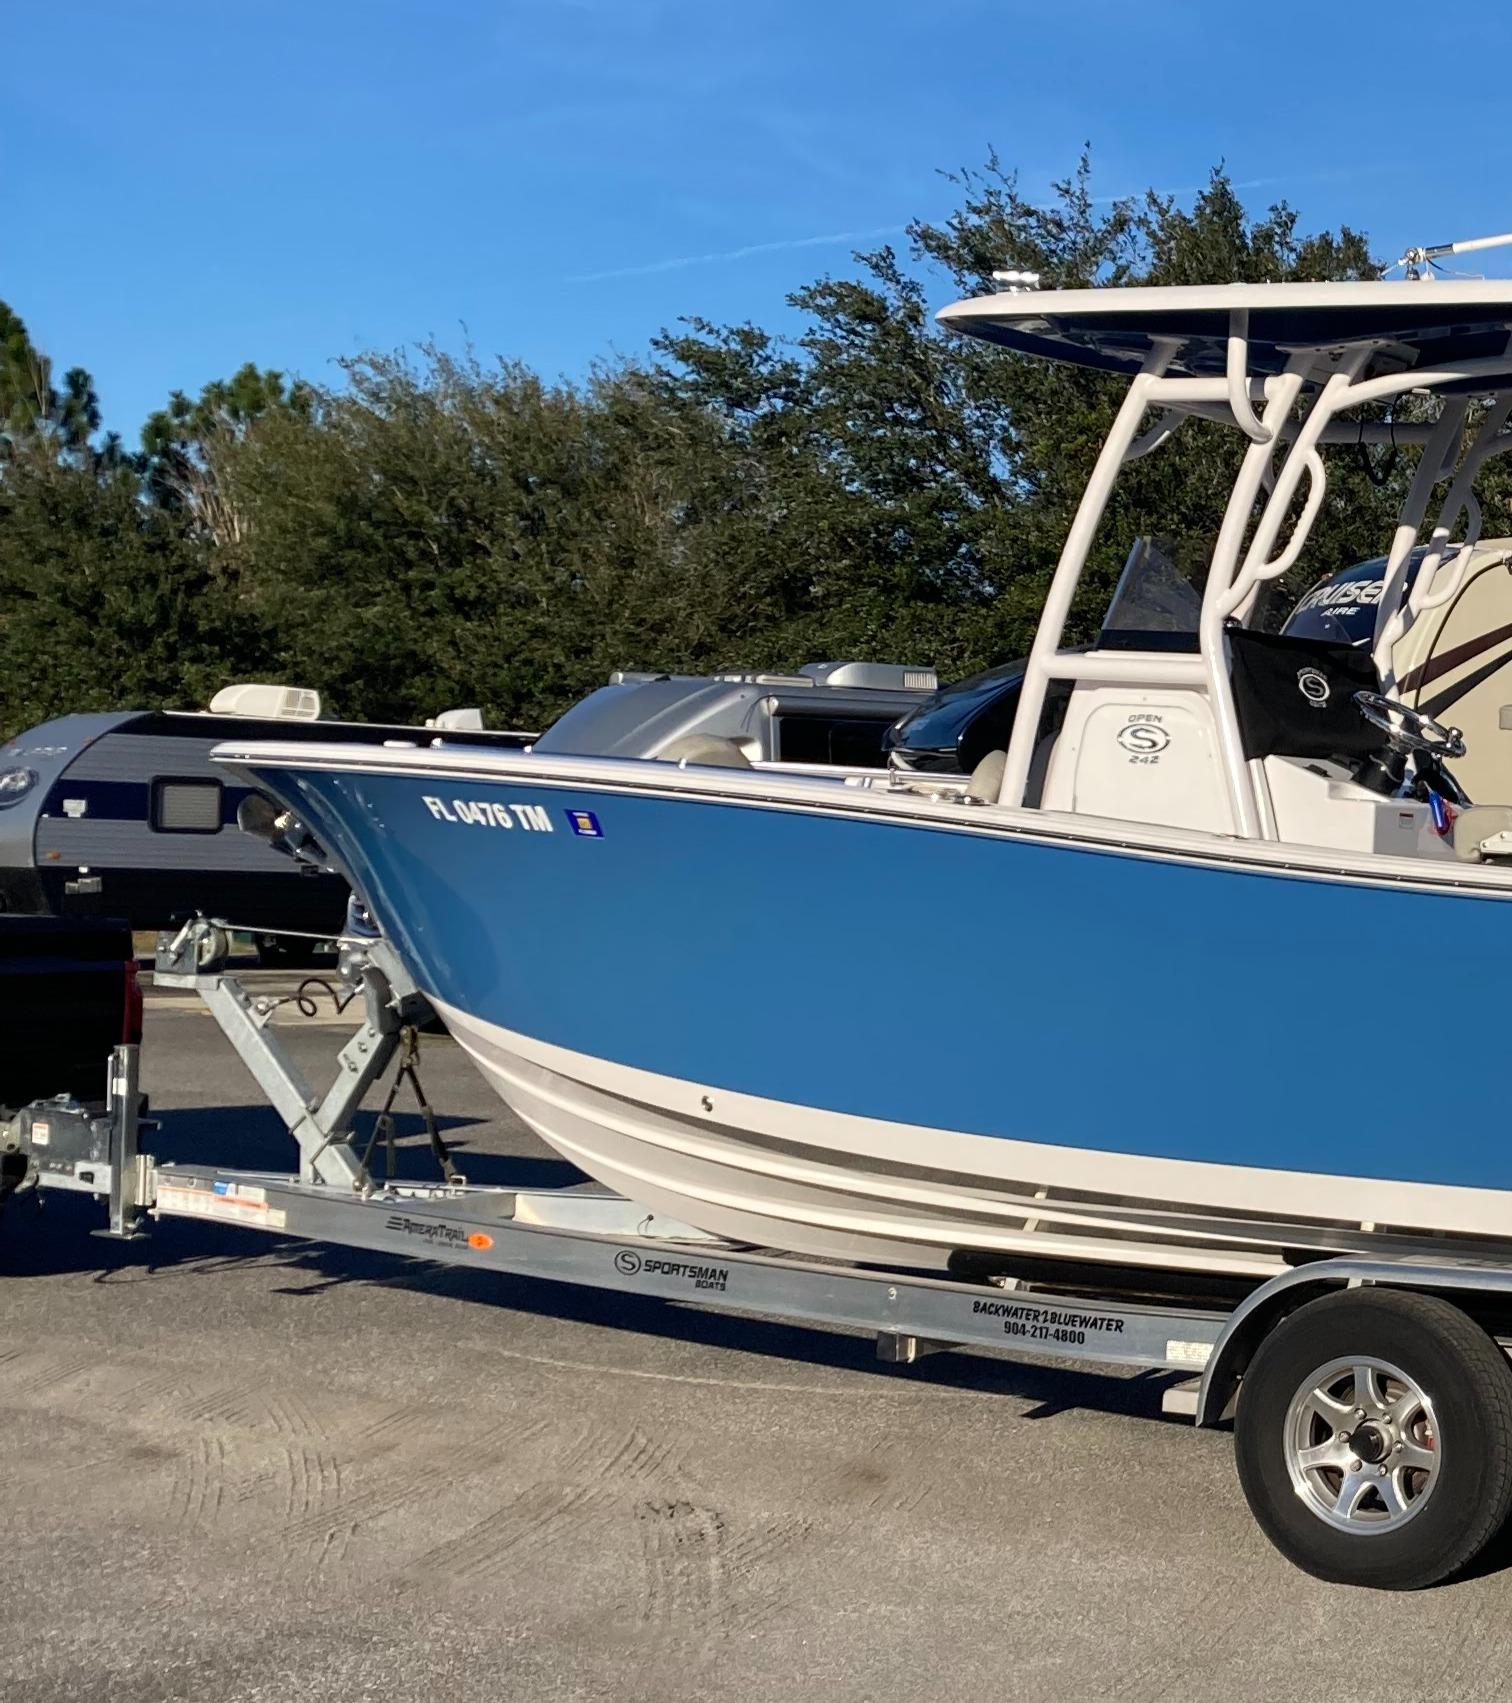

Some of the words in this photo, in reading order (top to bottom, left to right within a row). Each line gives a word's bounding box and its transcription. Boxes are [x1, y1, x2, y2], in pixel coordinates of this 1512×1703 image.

[1320, 607, 1360, 617] AIRE
[1128, 714, 1163, 723] OPEN
[1128, 755, 1159, 764] 242
[422, 796, 458, 822] FL
[453, 800, 513, 829] 0476
[509, 804, 553, 832] TM
[643, 1259, 729, 1282] SPORTSMAN
[695, 1279, 726, 1291] BOATS
[1003, 1320, 1086, 1345] 904-217-4800
